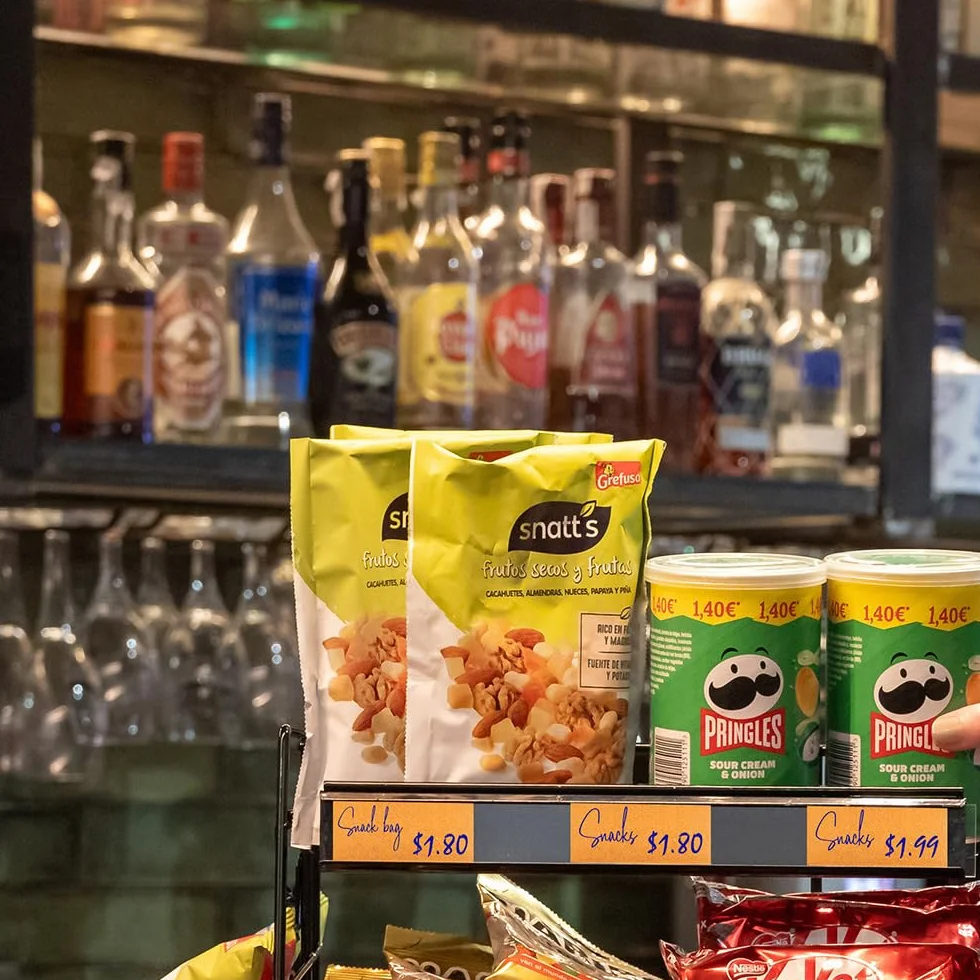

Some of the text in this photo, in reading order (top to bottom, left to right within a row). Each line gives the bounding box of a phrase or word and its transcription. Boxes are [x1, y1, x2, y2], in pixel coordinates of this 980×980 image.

[519, 507, 599, 541] snatt's
[482, 556, 632, 584] frutos secos y frutas
[485, 588, 525, 598] CACAHUETES,
[526, 587, 564, 597] ALMENDRAS,
[564, 587, 590, 596] NUECES,
[591, 587, 613, 595] PAPAYA
[597, 624, 613, 634] RICO
[588, 659, 610, 668] FUENTE
[704, 713, 782, 751] PRINGLES
[875, 718, 950, 754] PRINGL
[710, 759, 776, 770] SOUR CREAM
[721, 769, 765, 779] & ONION
[879, 763, 945, 773] SOUR CREAM
[890, 774, 934, 782] & ONION
[338, 804, 403, 851] Snack bag
[579, 806, 638, 848] Snacks
[815, 809, 875, 851] Snacks
[413, 832, 469, 857] $1.80
[647, 830, 704, 857] $1.80
[884, 833, 940, 860] $1.99
